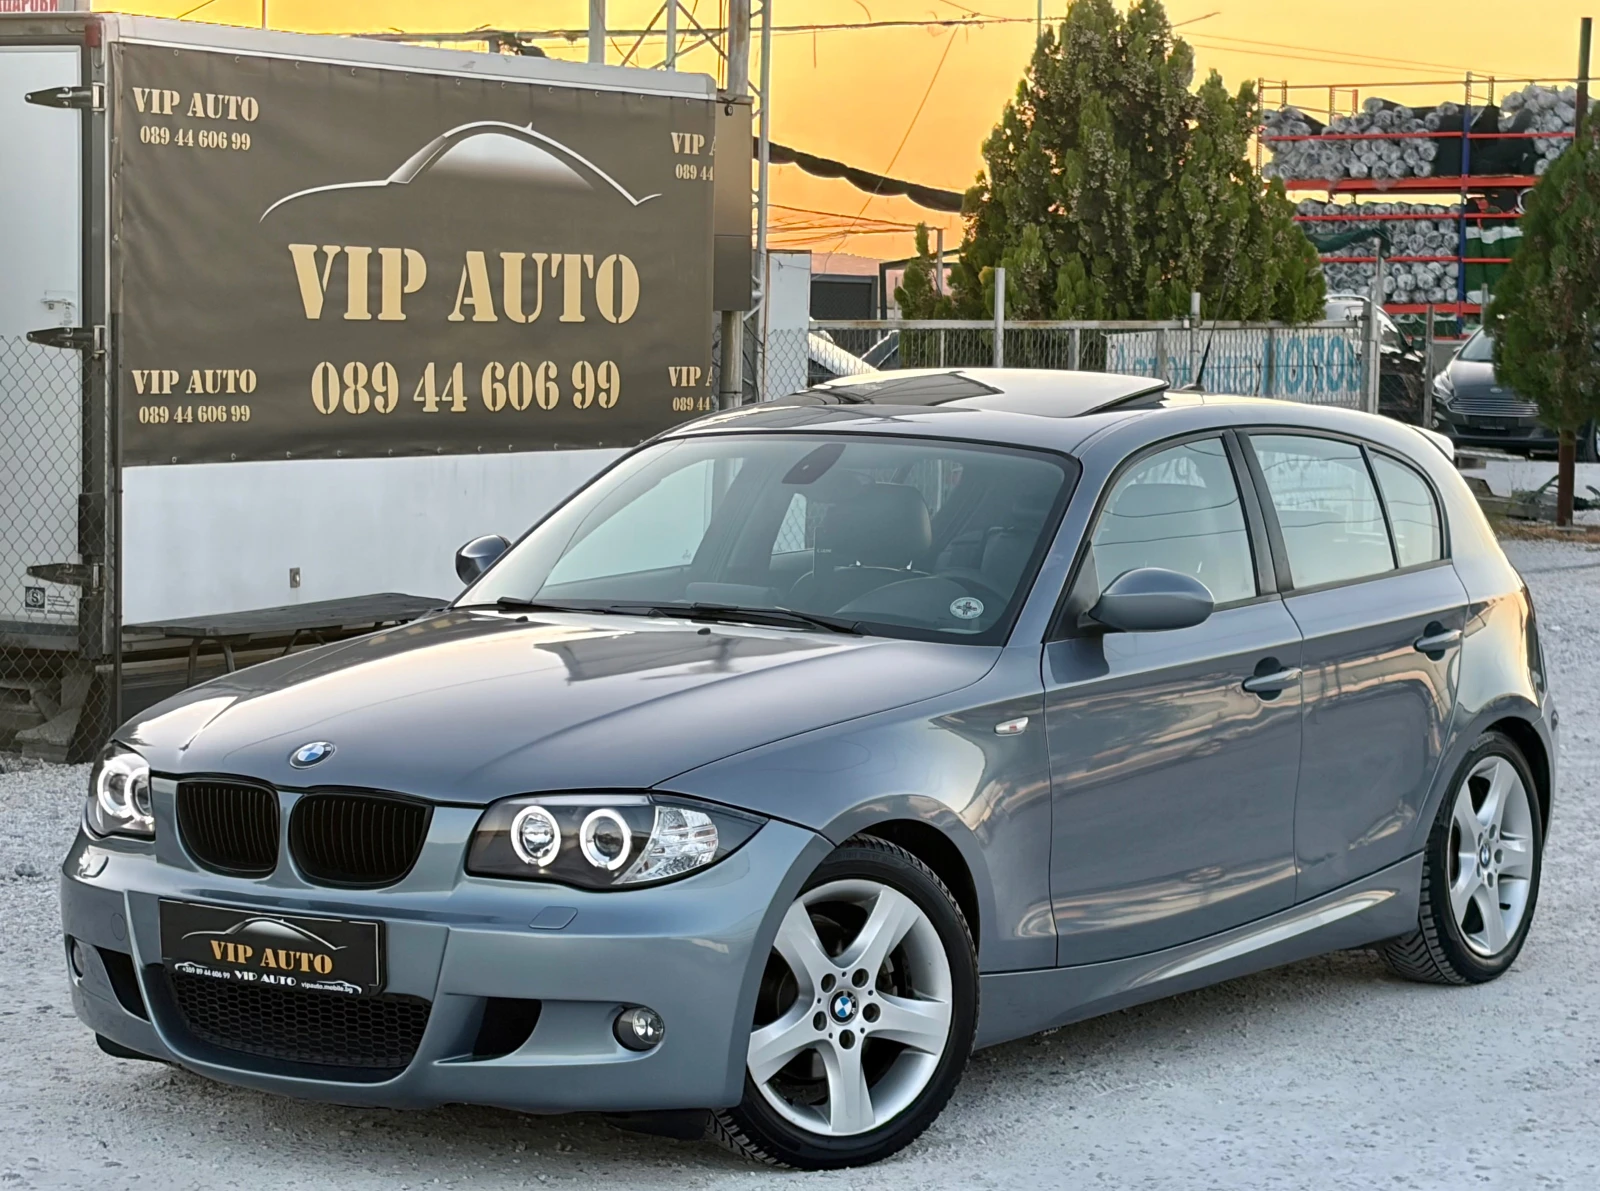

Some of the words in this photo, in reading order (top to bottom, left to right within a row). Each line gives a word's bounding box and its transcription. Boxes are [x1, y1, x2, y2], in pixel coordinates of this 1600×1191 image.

[132, 87, 180, 116] VIP
[187, 92, 258, 121] AUTO
[139, 126, 170, 146] 089
[173, 128, 194, 147] 44
[198, 130, 227, 149] 606
[231, 132, 251, 151] 99
[671, 132, 705, 155] VIP
[675, 163, 697, 180] 089
[700, 165, 714, 181] 44
[288, 243, 427, 321] VIP
[448, 250, 640, 324] AUTO
[131, 369, 180, 395] VIP
[185, 369, 256, 394] AUTO
[311, 361, 398, 415] 089
[413, 361, 468, 413] 44
[481, 360, 560, 412] 606
[571, 360, 620, 409] 99
[668, 366, 702, 387] VIP
[138, 405, 169, 424] 089
[173, 405, 193, 424] 44
[198, 405, 227, 423] 606
[231, 405, 251, 422] 99
[672, 396, 694, 411] 089
[696, 396, 710, 411] 44
[210, 940, 253, 964] VIP
[260, 947, 333, 974] AUTO
[234, 969, 258, 982] VIP
[260, 973, 297, 987] AUTO
